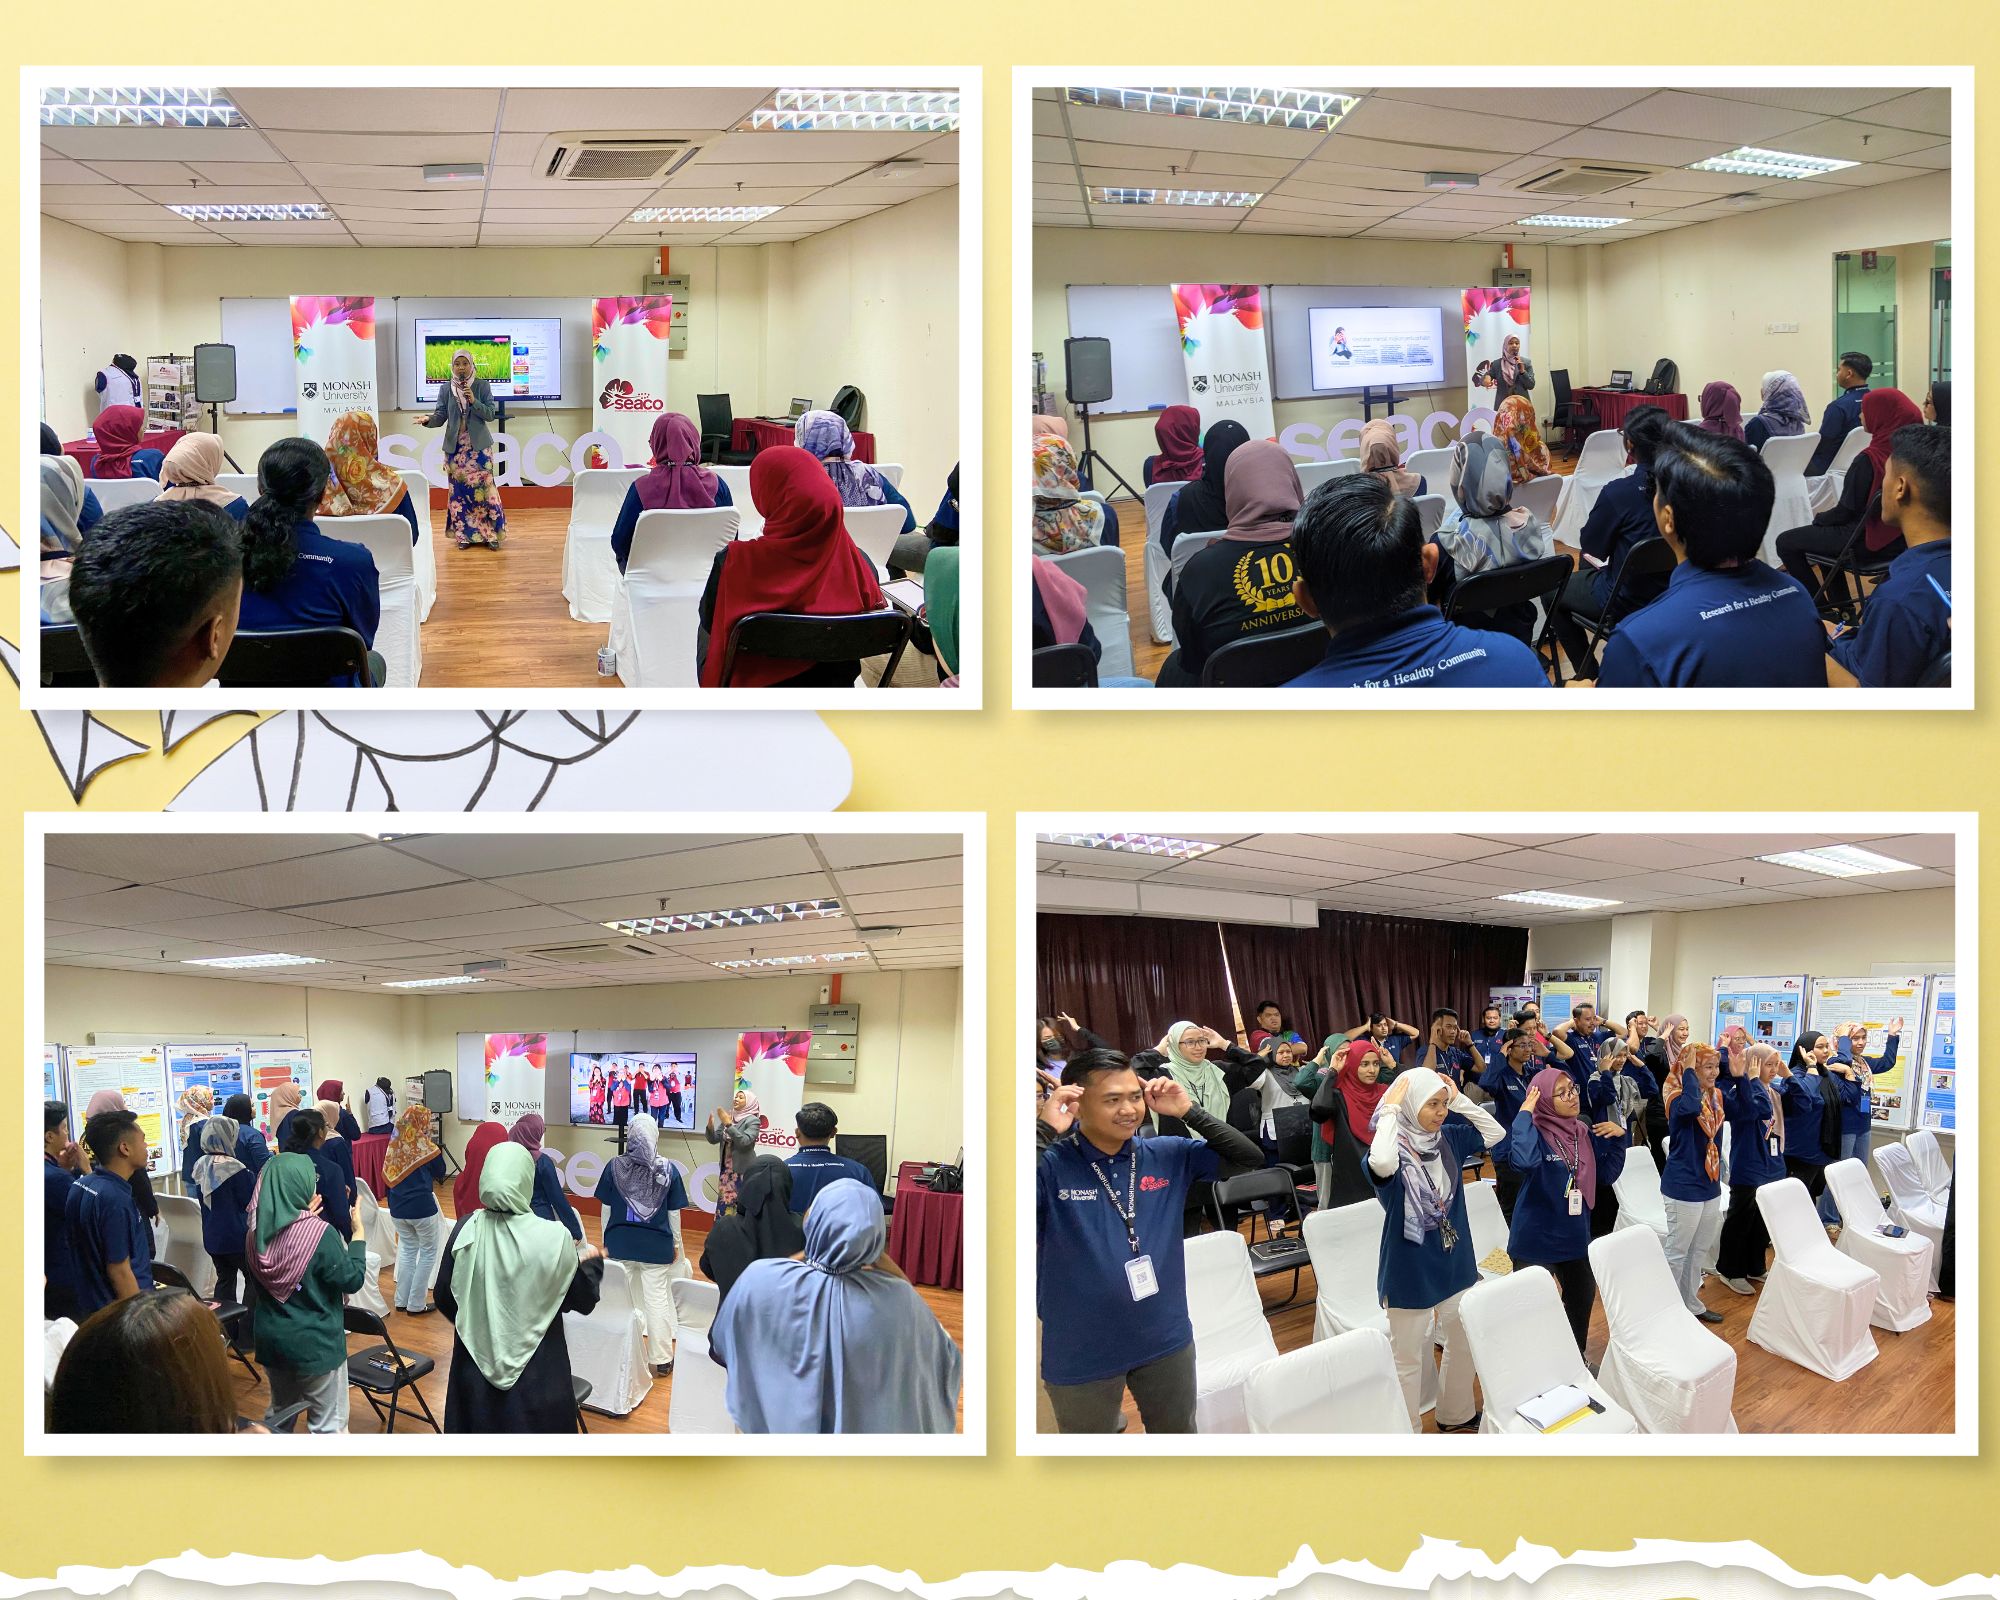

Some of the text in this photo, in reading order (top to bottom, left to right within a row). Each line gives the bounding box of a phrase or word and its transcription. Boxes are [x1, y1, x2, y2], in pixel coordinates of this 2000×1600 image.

[1213, 371, 1262, 384] MONASH
[322, 381, 371, 391] MONASH
[1214, 382, 1260, 394] University
[323, 391, 369, 401] University
[614, 399, 664, 410] seaco
[1216, 397, 1265, 407] MALAYSIA
[298, 552, 334, 563] Community
[1254, 552, 1293, 588] 10
[1266, 585, 1290, 596] YEARS
[1699, 604, 1733, 620] Research
[1733, 601, 1744, 610] for
[1748, 594, 1772, 606] Healthy
[1364, 647, 1487, 688] for a Healthy Community
[505, 1102, 541, 1110] MONASH
